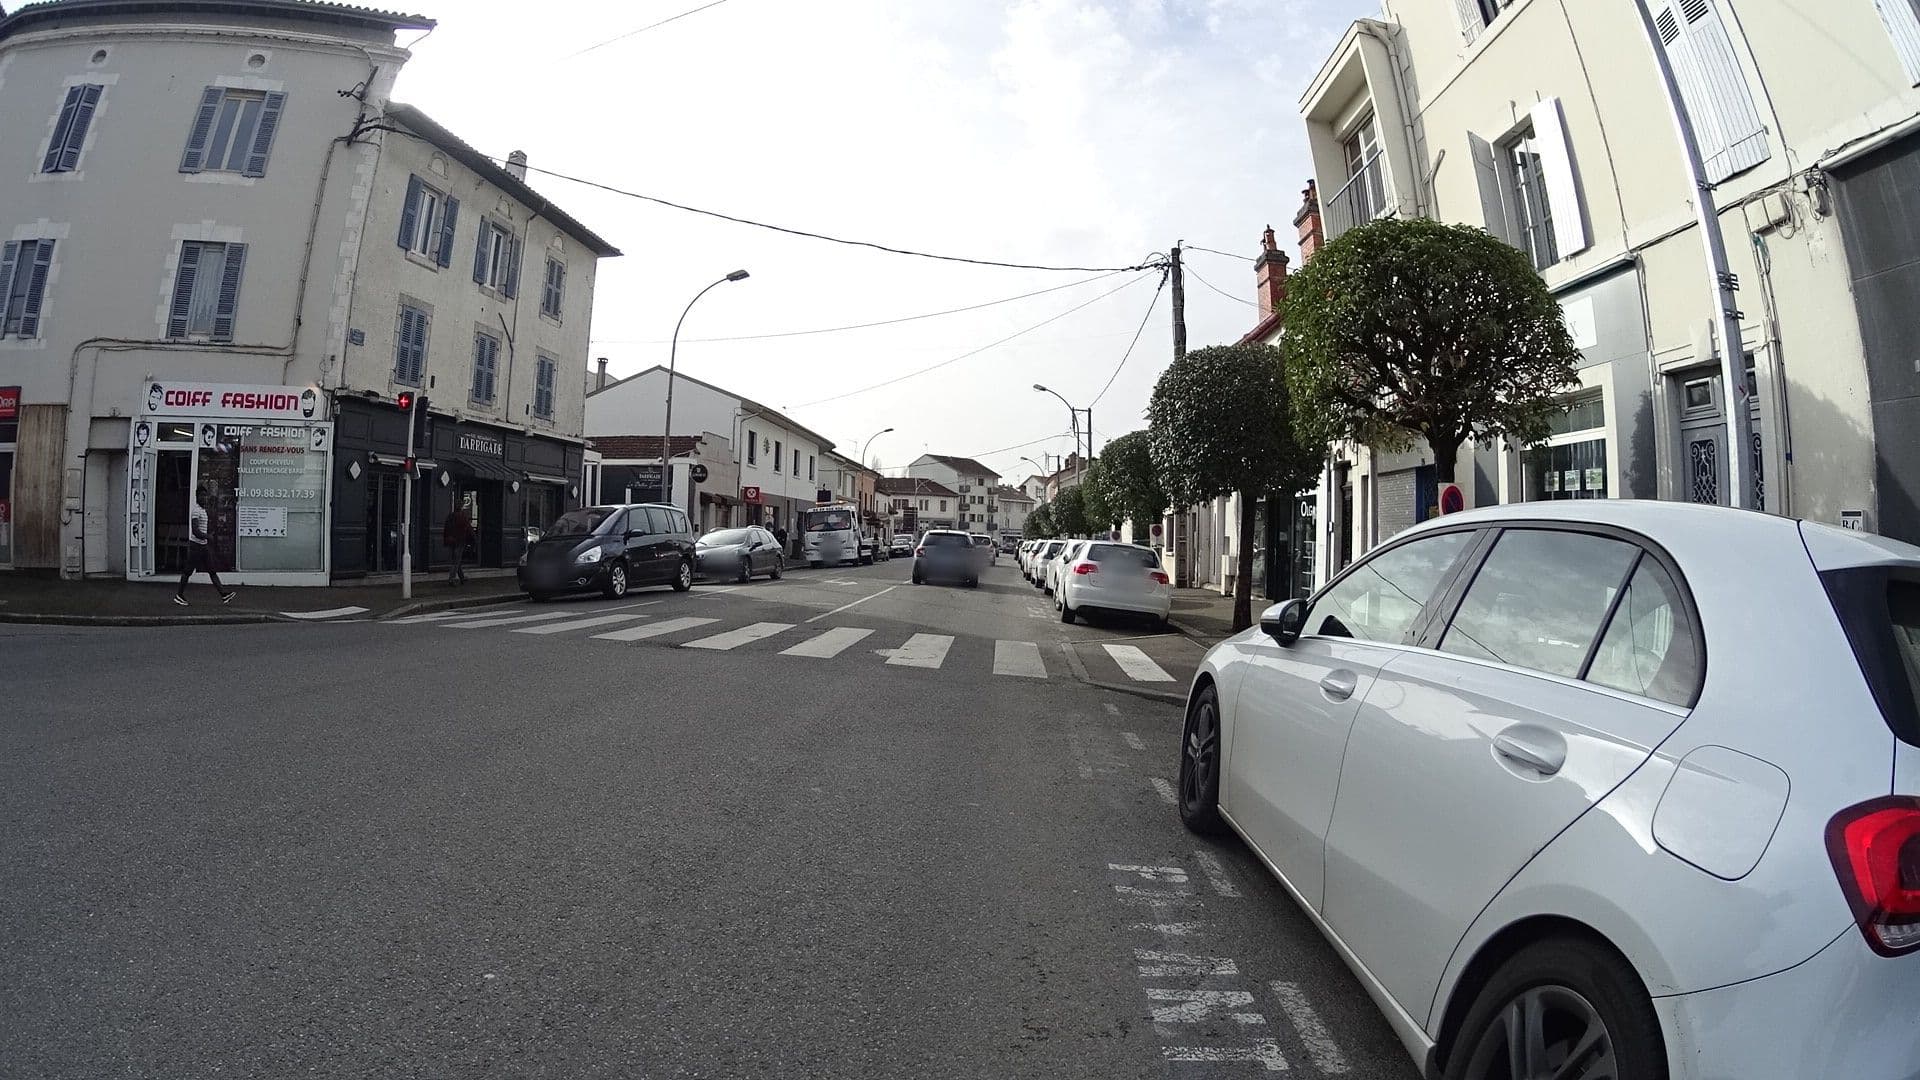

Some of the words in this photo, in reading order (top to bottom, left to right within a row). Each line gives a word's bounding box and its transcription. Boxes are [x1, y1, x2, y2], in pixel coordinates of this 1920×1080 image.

[165, 390, 213, 407] COIFF
[221, 392, 299, 411] FASHION
[223, 426, 253, 437] COIFF
[260, 427, 305, 438] FASHION
[240, 445, 257, 454] SANS
[259, 446, 305, 454] RENDEZ-VOUS
[250, 488, 315, 499] 09.88.32.17.39
